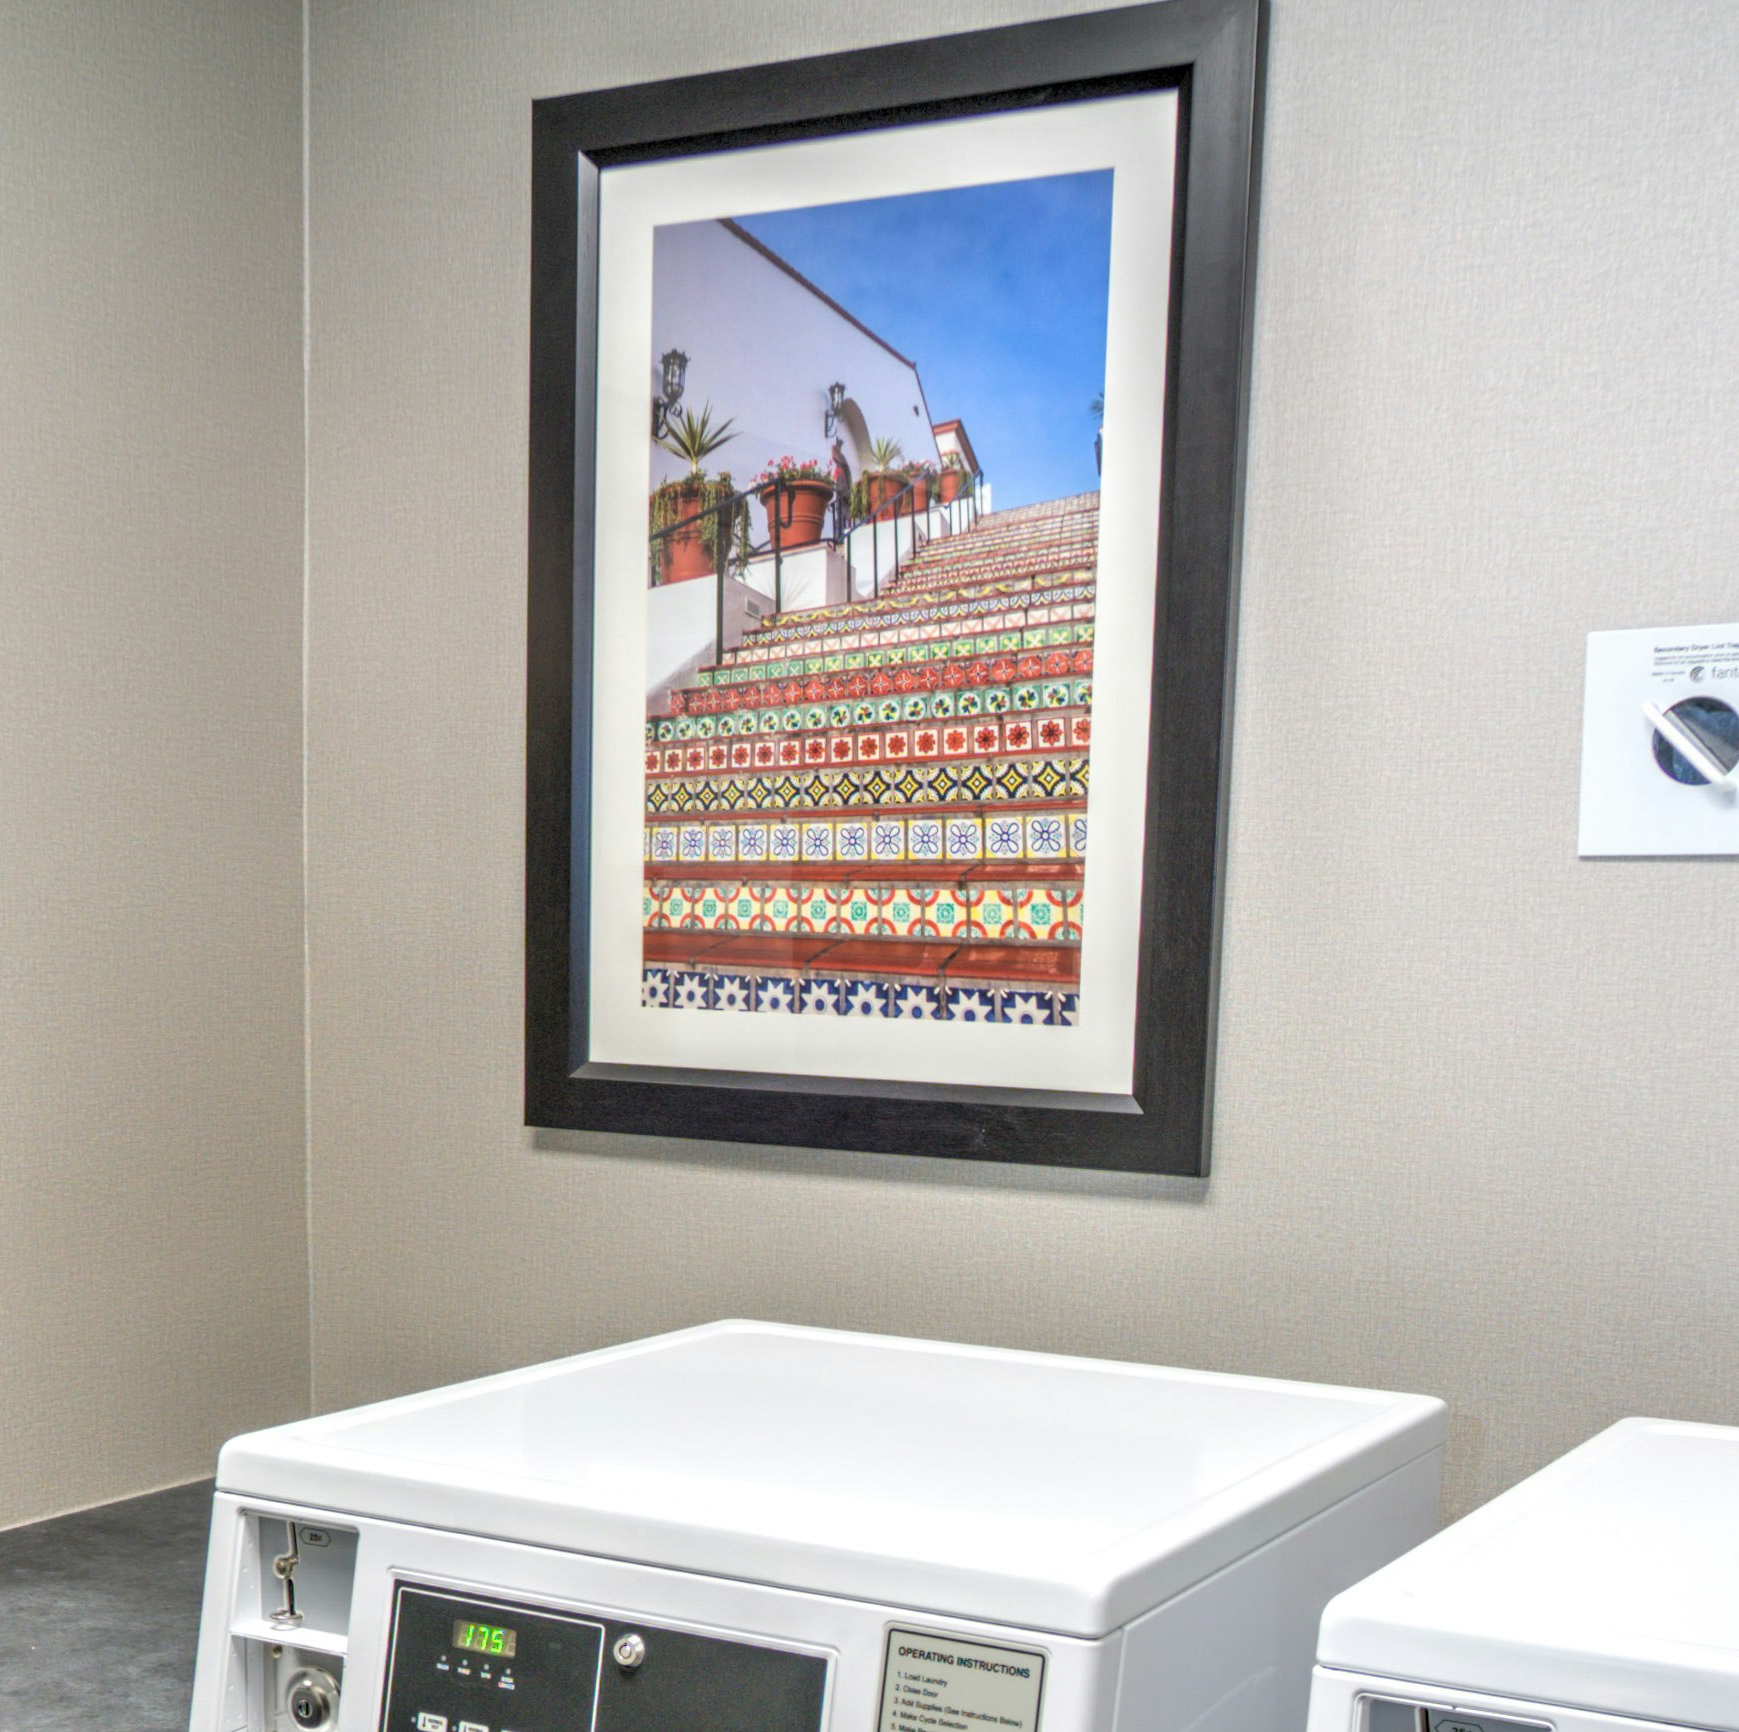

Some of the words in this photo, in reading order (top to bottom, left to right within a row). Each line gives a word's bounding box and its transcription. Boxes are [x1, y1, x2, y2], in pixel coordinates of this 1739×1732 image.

[899, 1647, 954, 1665] OPERATING
[957, 1657, 1030, 1678] INSTRUCTIONS
[905, 1672, 920, 1681] Load
[922, 1676, 948, 1687] Laundry
[903, 1685, 921, 1695] Close
[923, 1689, 938, 1698] Door
[902, 1698, 913, 1706] Add
[916, 1701, 942, 1713] Supplies
[901, 1712, 917, 1721] Make
[919, 1715, 936, 1725] Cycle
[939, 1719, 968, 1730] Selection
